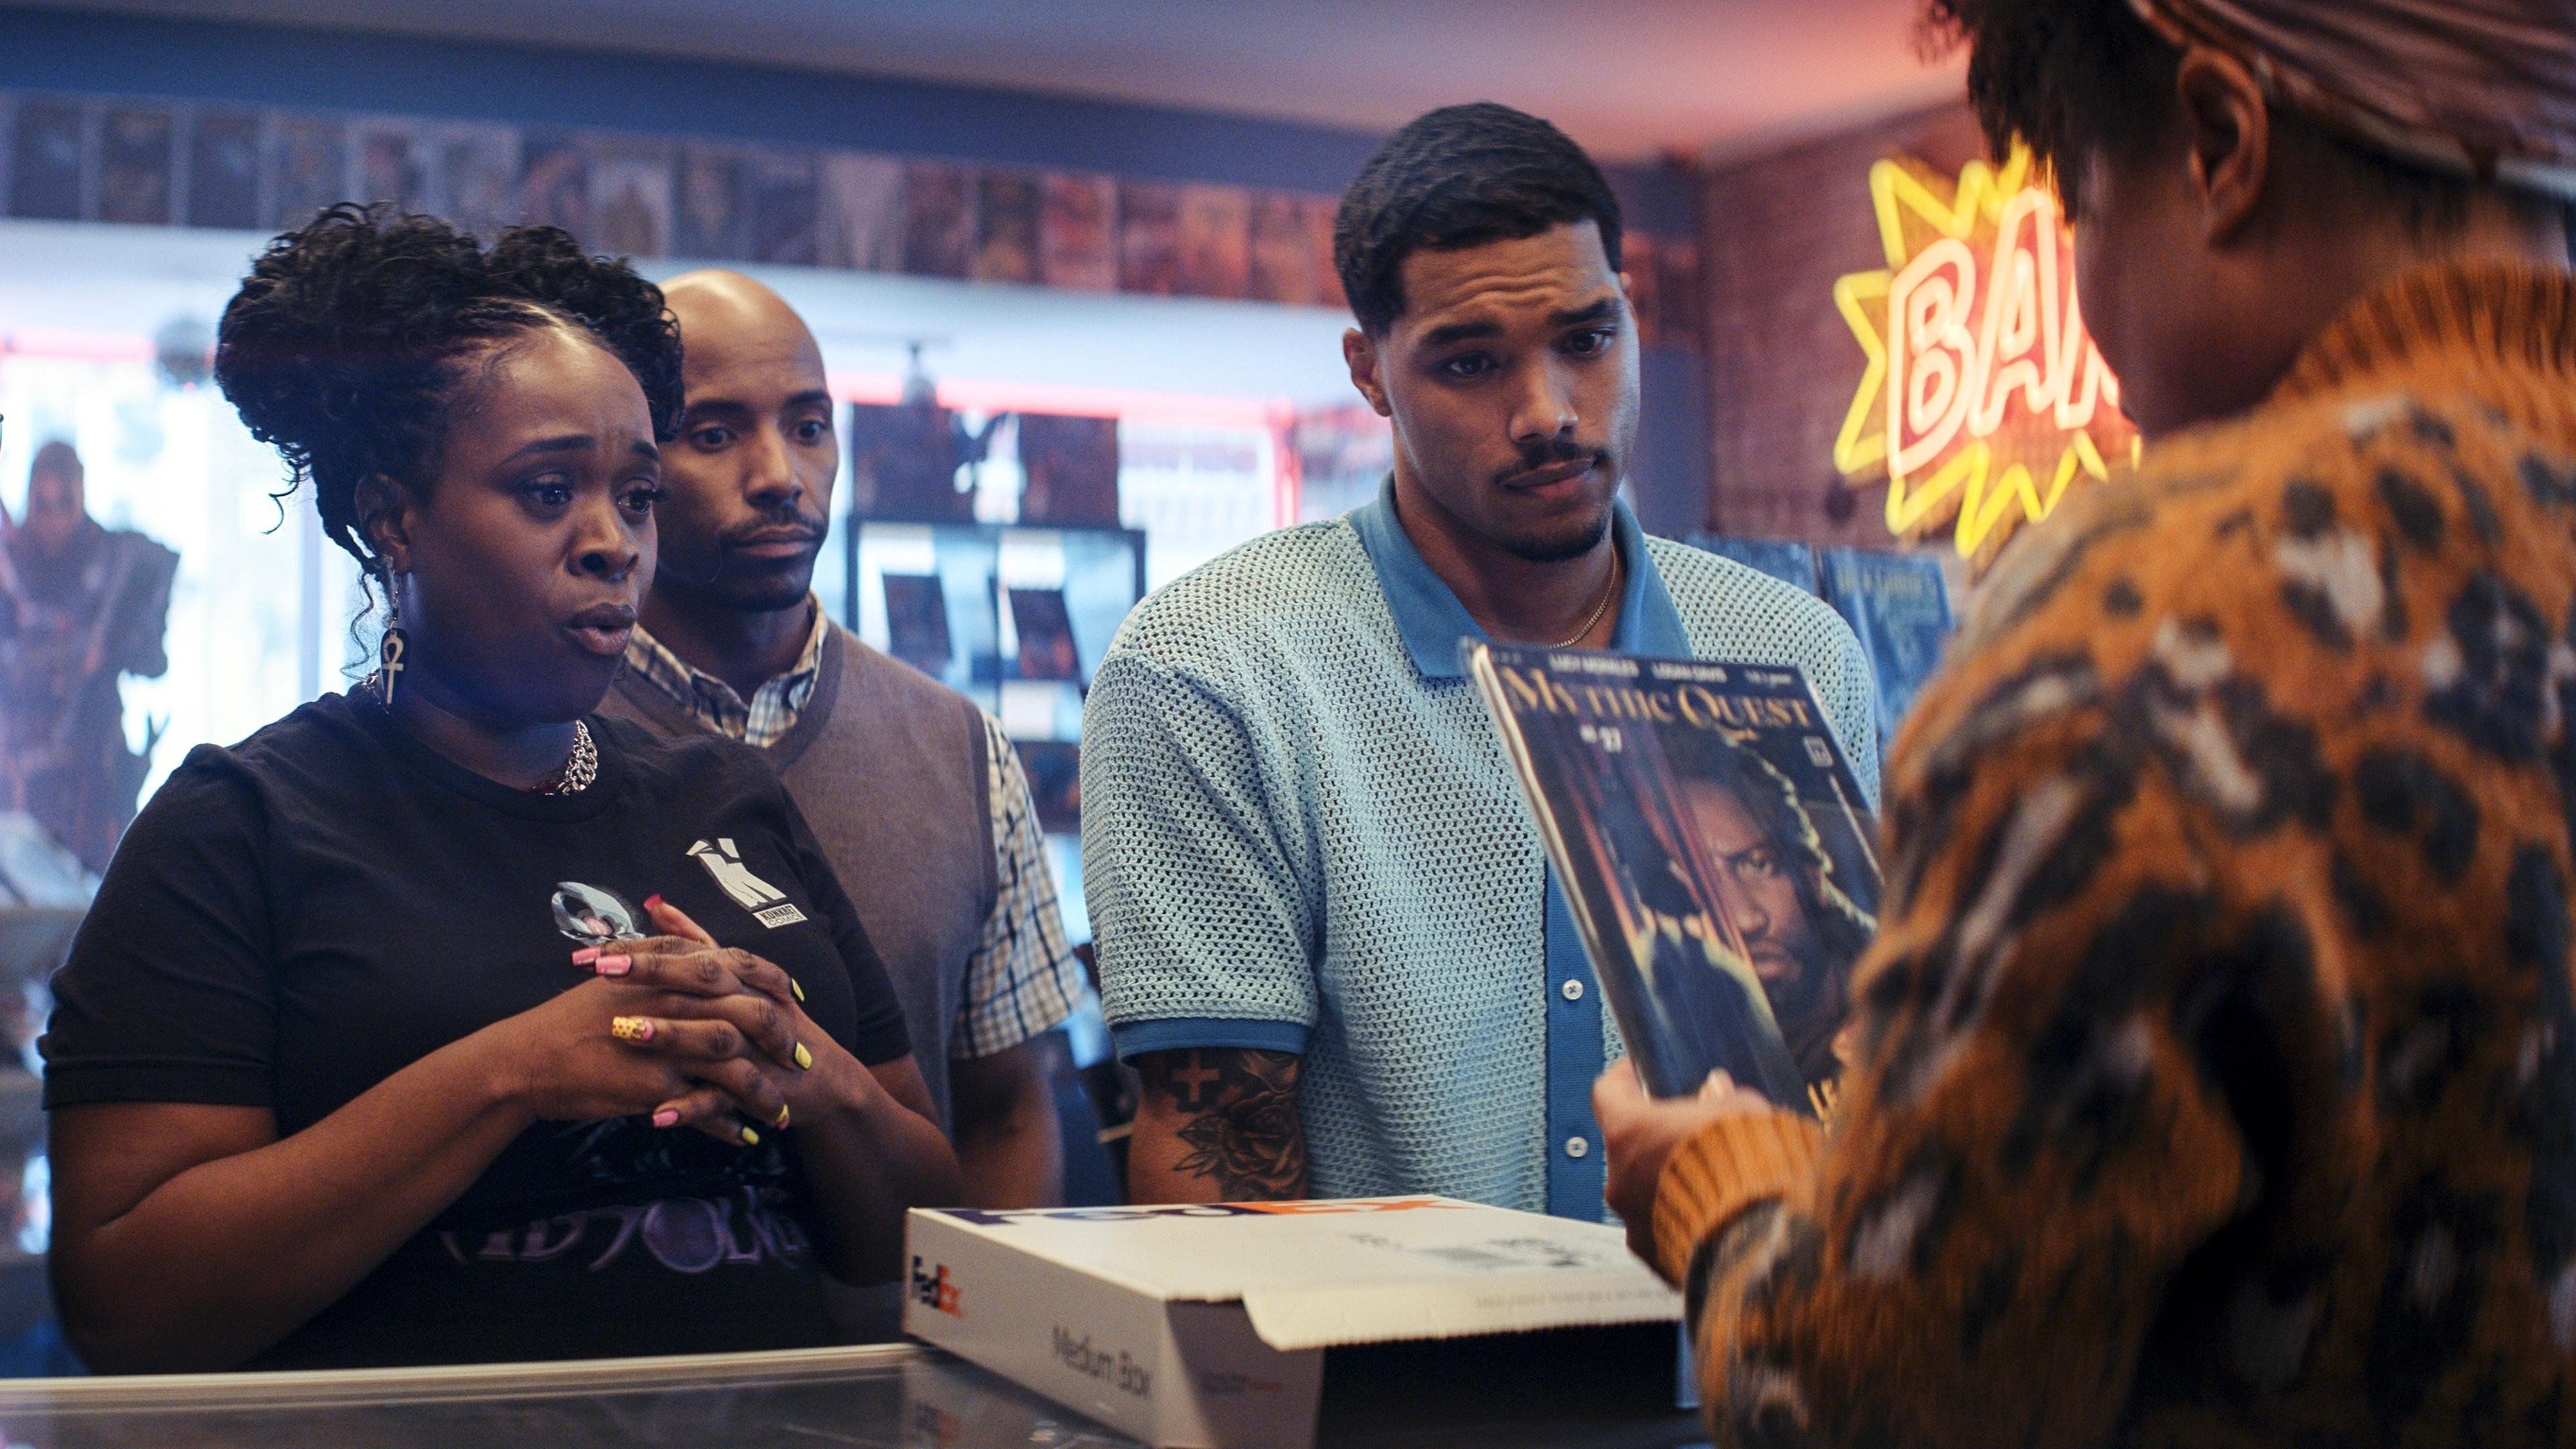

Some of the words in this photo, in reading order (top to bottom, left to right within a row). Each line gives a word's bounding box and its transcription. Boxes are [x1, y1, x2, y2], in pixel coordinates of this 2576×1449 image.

[1678, 683, 1811, 742] QUEST
[759, 905, 798, 922] KONKRET
[767, 912, 804, 926] COMICS
[1053, 1324, 1113, 1385] Medium
[1118, 1350, 1152, 1398] Box
